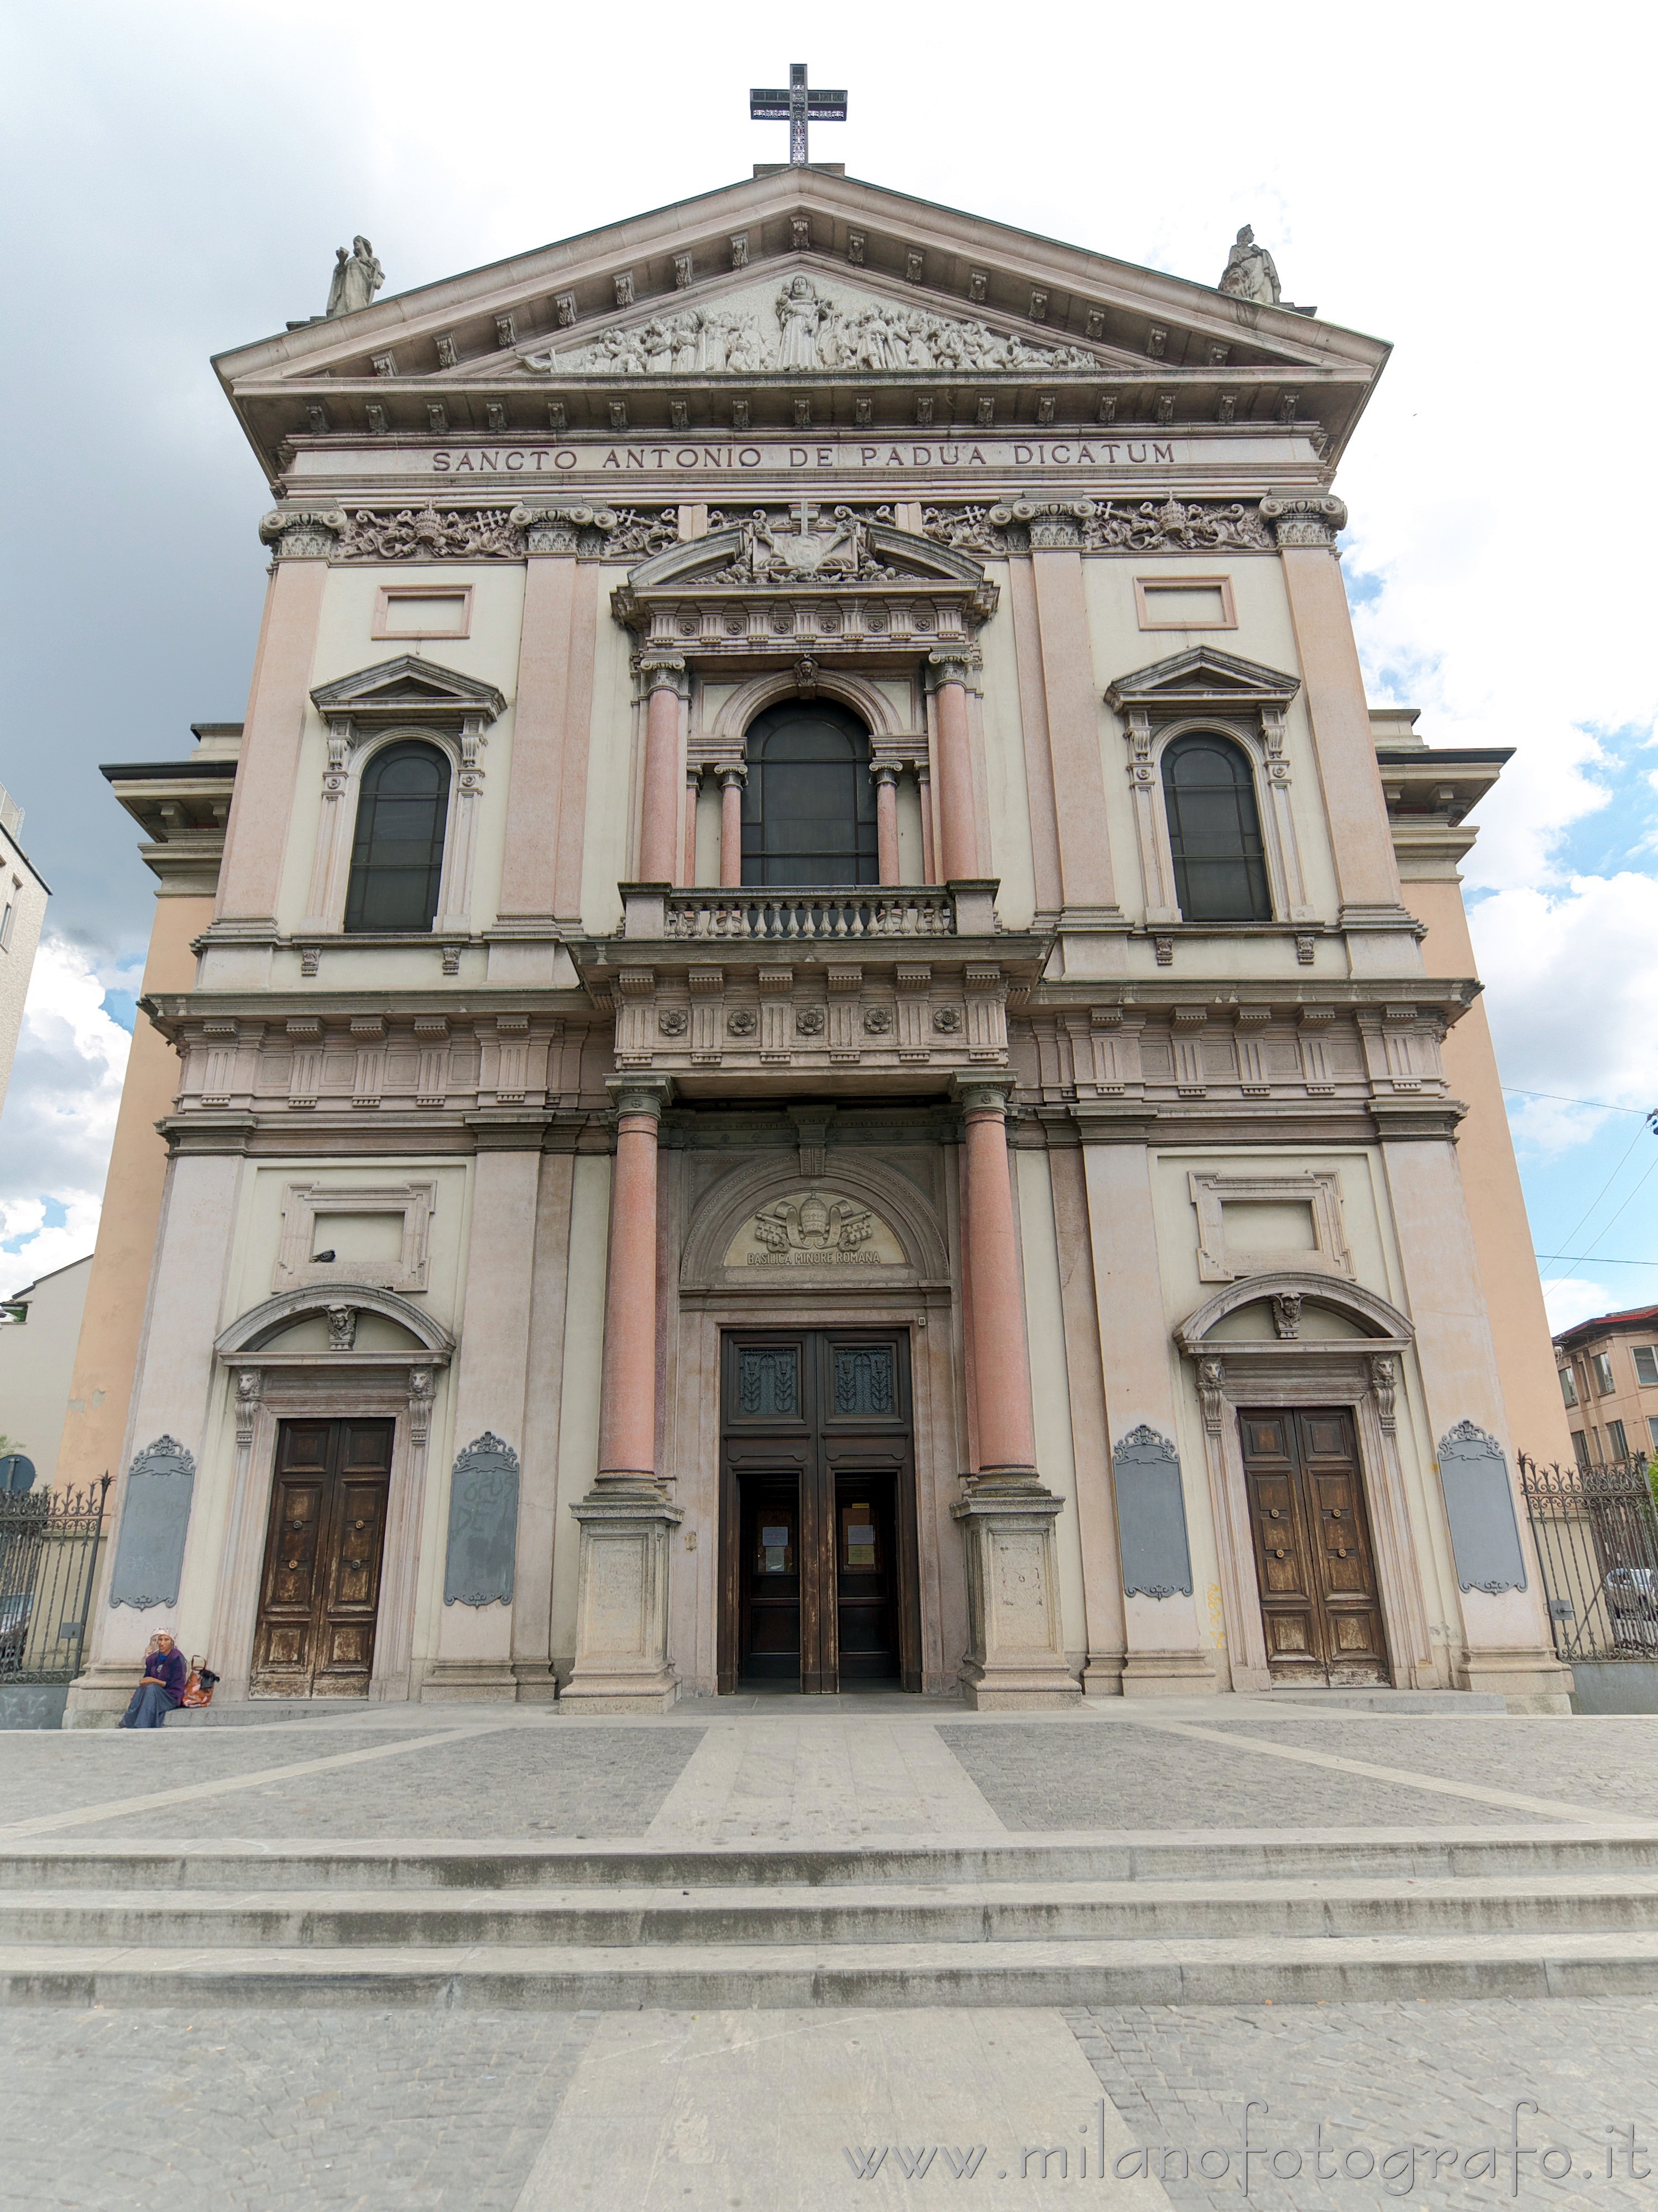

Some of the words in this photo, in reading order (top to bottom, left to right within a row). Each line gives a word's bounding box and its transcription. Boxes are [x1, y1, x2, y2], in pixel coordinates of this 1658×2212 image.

[433, 450, 578, 471] SANCTO
[603, 448, 762, 468] ANTONIO
[789, 447, 833, 467] DE
[861, 446, 986, 466] PADUA
[1014, 444, 1175, 465] DICATUM
[747, 1253, 792, 1265] BASILICA
[794, 1252, 833, 1264] MINORE
[836, 1251, 881, 1264] ROMANA
